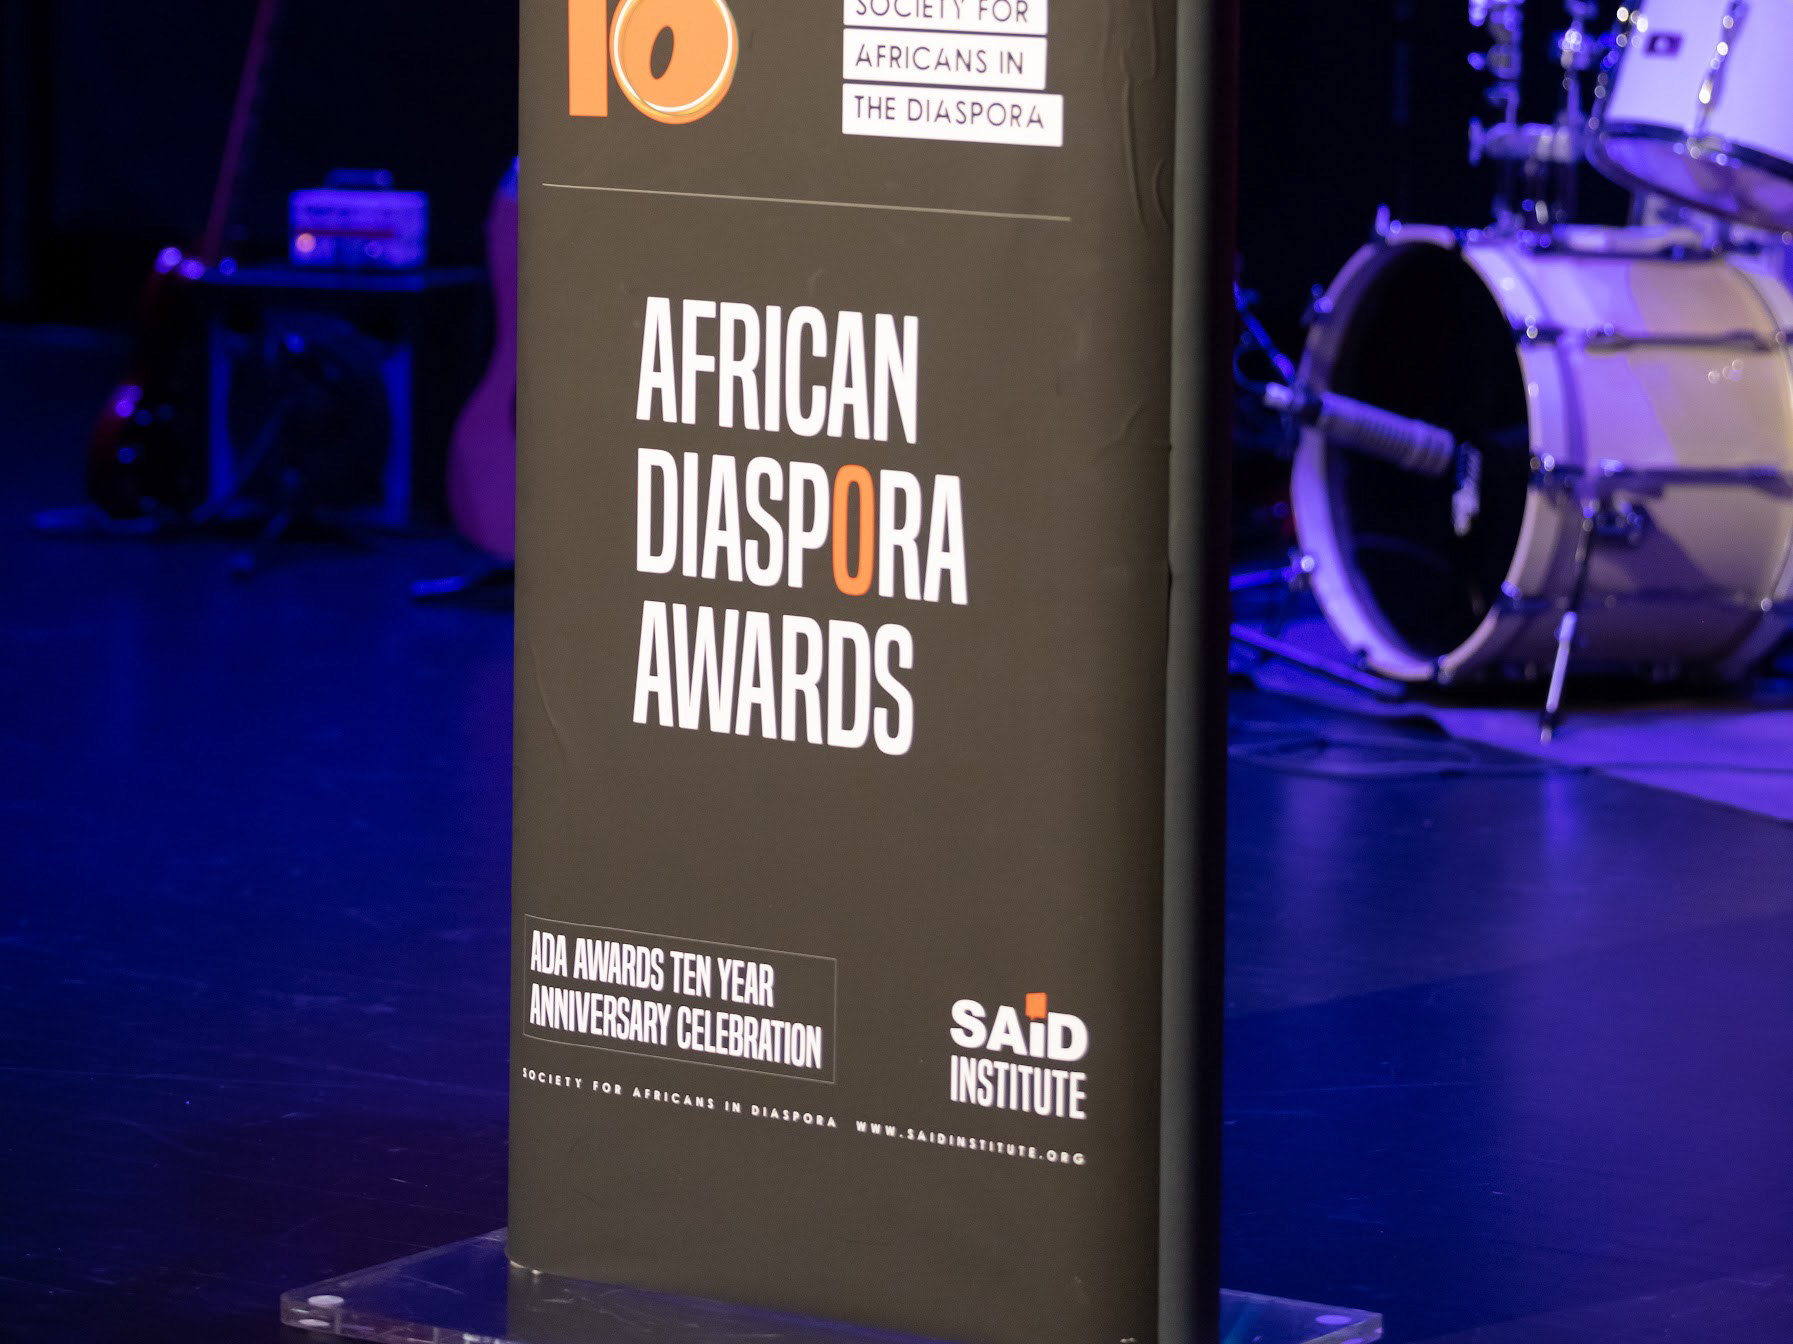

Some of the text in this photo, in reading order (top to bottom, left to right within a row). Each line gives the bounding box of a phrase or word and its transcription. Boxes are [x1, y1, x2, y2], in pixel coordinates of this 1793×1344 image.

[855, 43, 1023, 75] AFRICANS IN
[854, 94, 1045, 130] THE DIASPORA
[636, 296, 919, 444] AFRICAN
[636, 447, 968, 605] DIASPORA
[633, 600, 914, 756] AWARDS
[530, 929, 775, 1008] ADA AWARDS TEN YEAR
[529, 983, 822, 1069] ANNIVERSARY CELEBRATION
[522, 1067, 1086, 1166] SOCIETY FOR AFRICANS IN DIASPORA WWW.SAIDINSTITUTE.ORG
[950, 1054, 1088, 1120] INSTITUTE
